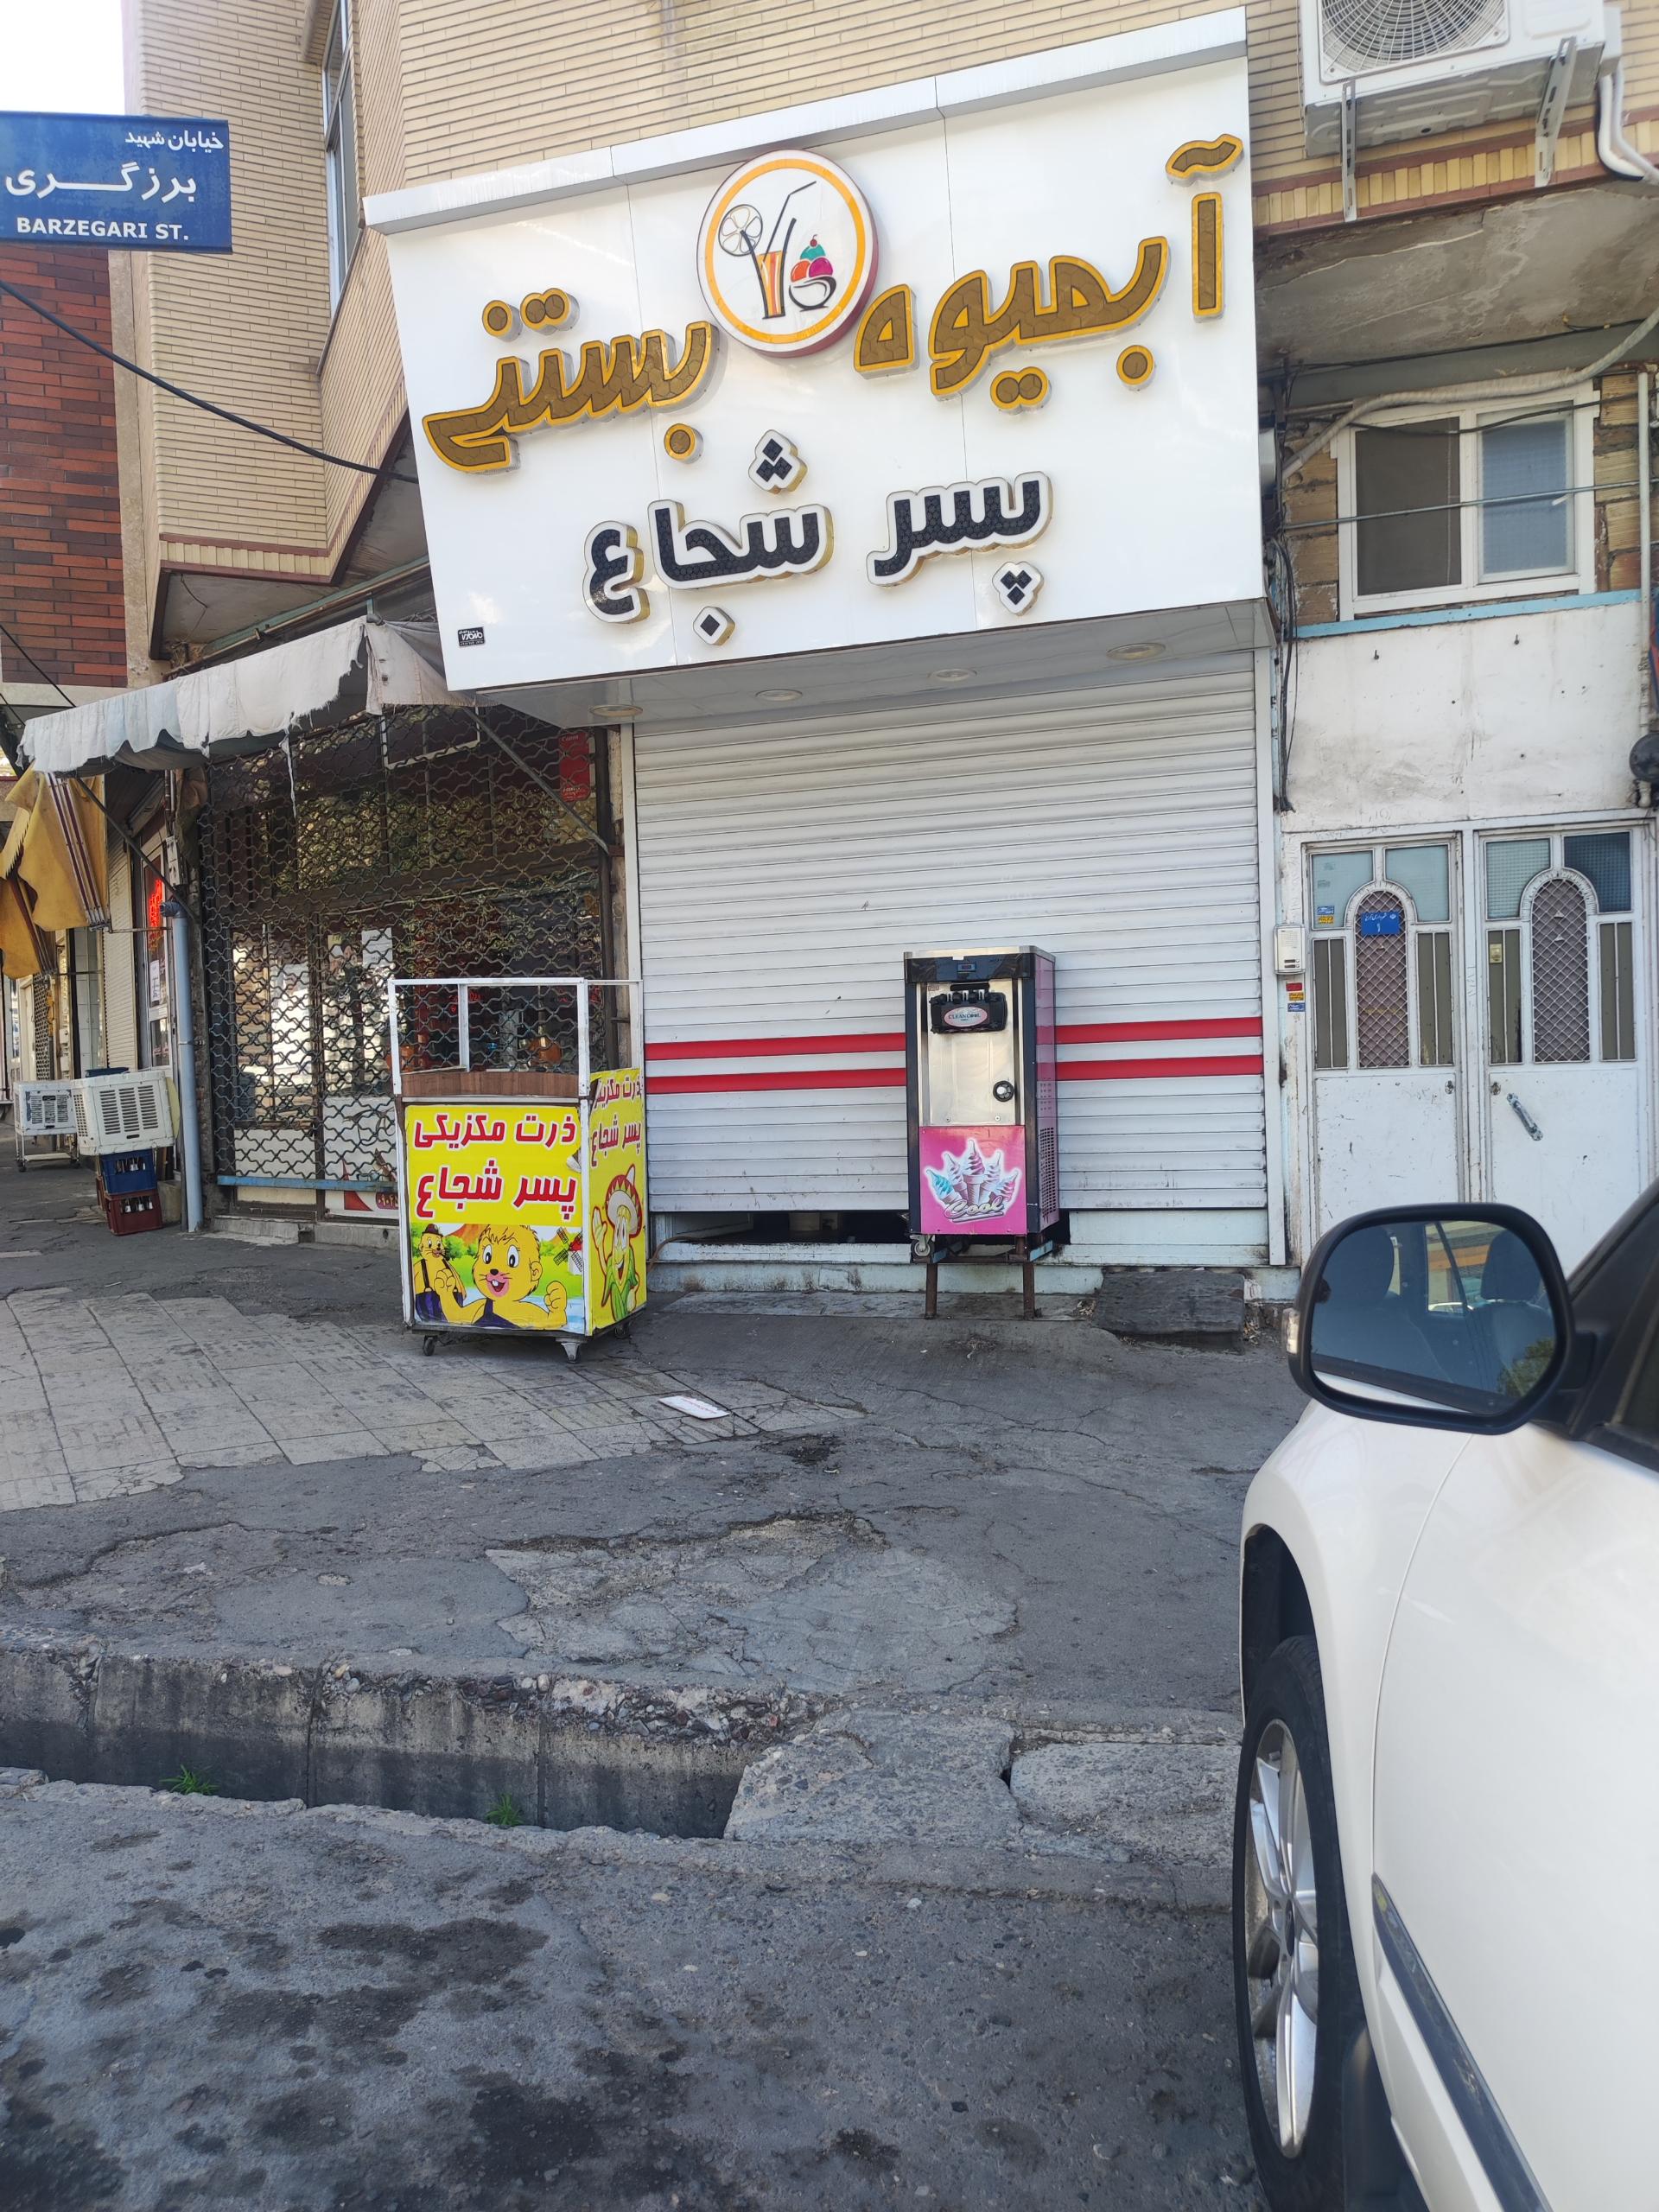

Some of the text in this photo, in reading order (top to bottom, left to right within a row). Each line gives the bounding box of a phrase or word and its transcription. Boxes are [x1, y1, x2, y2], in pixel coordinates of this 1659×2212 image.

[125, 130, 224, 153] خیابان شهید
[5, 162, 197, 203] برزگری
[16, 217, 188, 240] BARZEGARI ST.
[422, 134, 1243, 472] آبمیوه بستنی
[583, 429, 1051, 645] پسر شجاع
[415, 1114, 576, 1148] ذرت مکزیکی
[591, 1114, 641, 1167] پسر شجاع
[416, 1160, 576, 1220] پسر شجاع
[944, 1195, 1005, 1219] Cool
